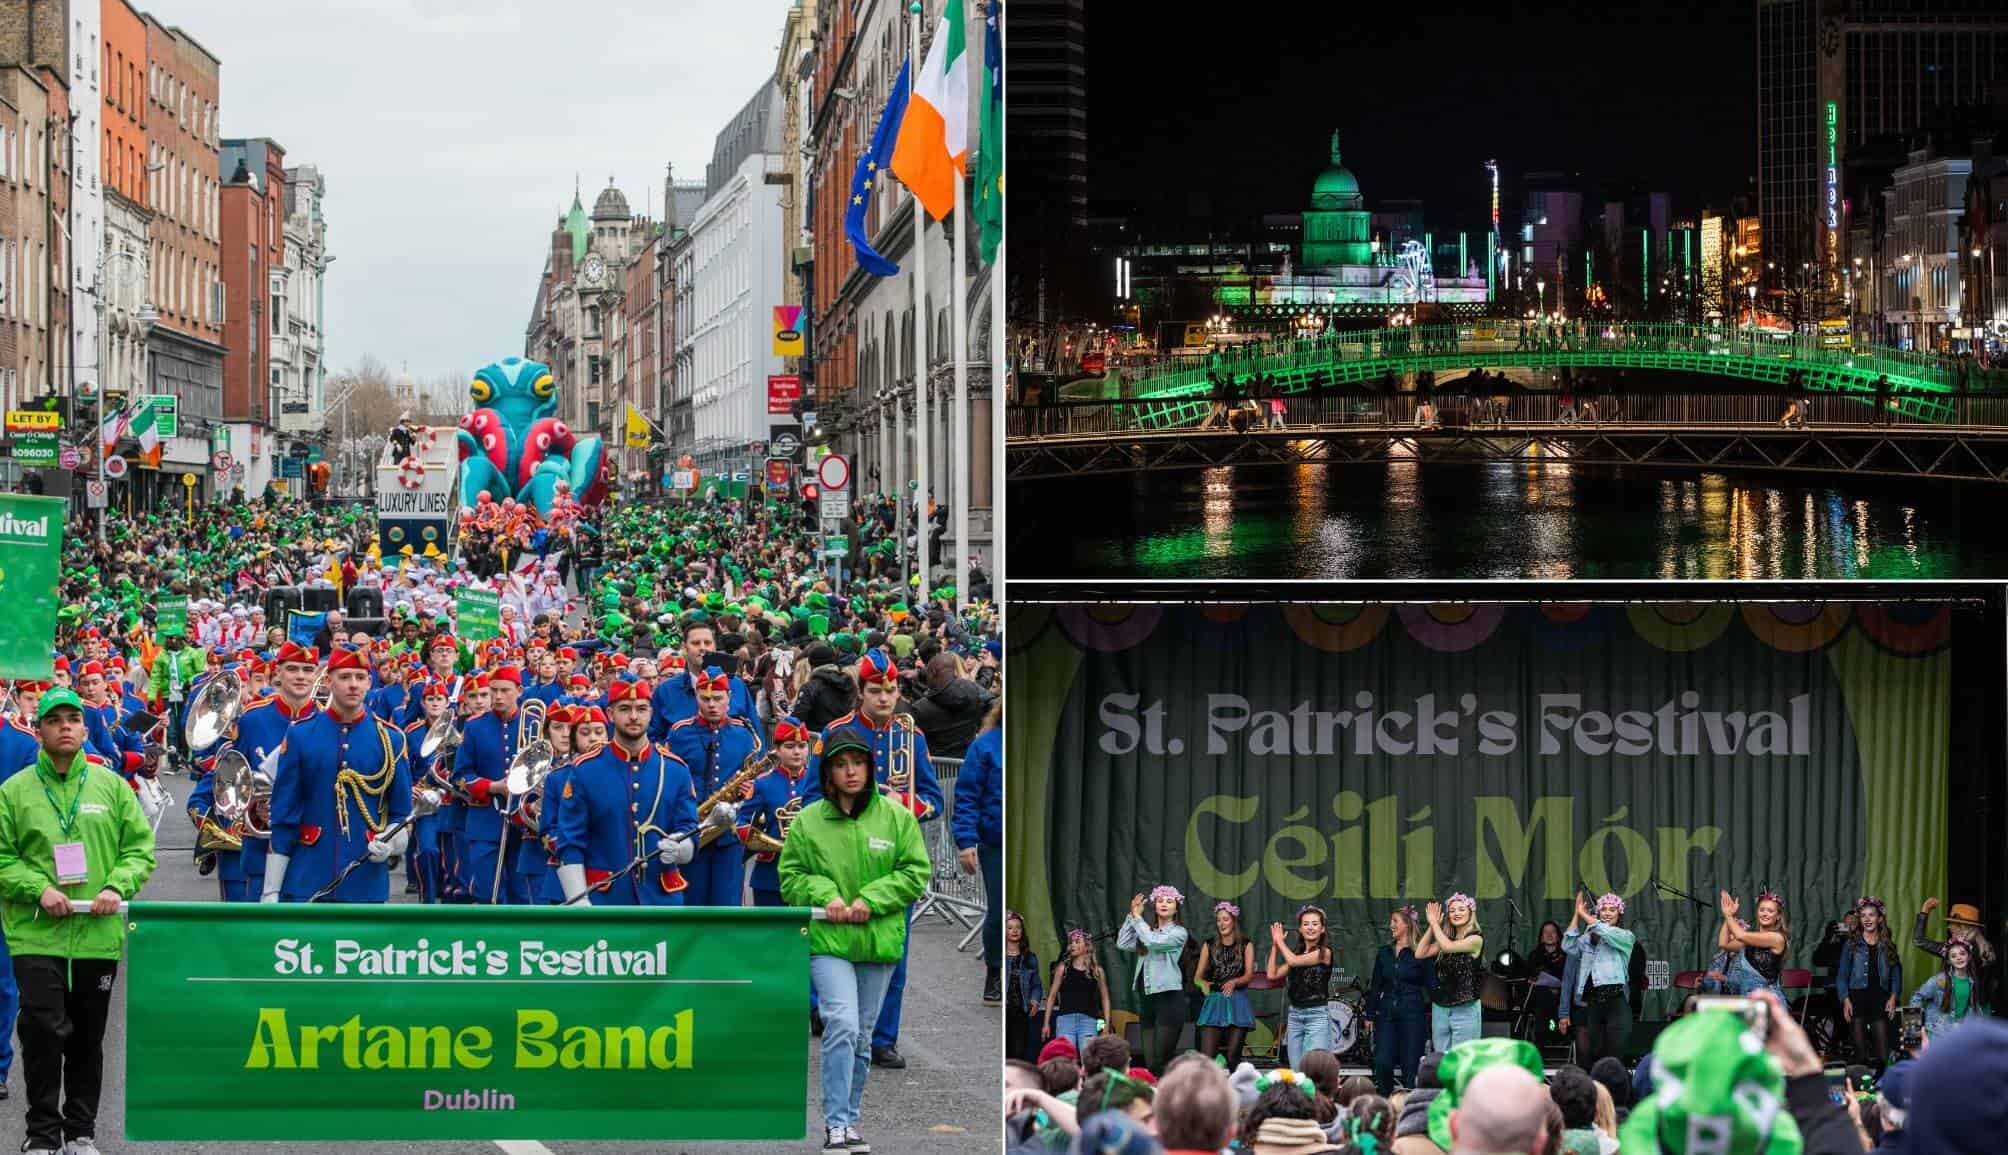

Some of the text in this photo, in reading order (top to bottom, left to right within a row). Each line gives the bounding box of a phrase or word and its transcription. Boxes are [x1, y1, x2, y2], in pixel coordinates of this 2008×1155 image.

[13, 415, 52, 423] LET BY
[379, 492, 447, 513] LUXURY LINES
[1099, 691, 1810, 756] St. Patrick's Festival
[1185, 790, 1723, 901] Céilí Mór
[274, 938, 667, 976] St. Patrick's Festival
[244, 1007, 694, 1070] Artane Band
[423, 1088, 516, 1110] Dublin
